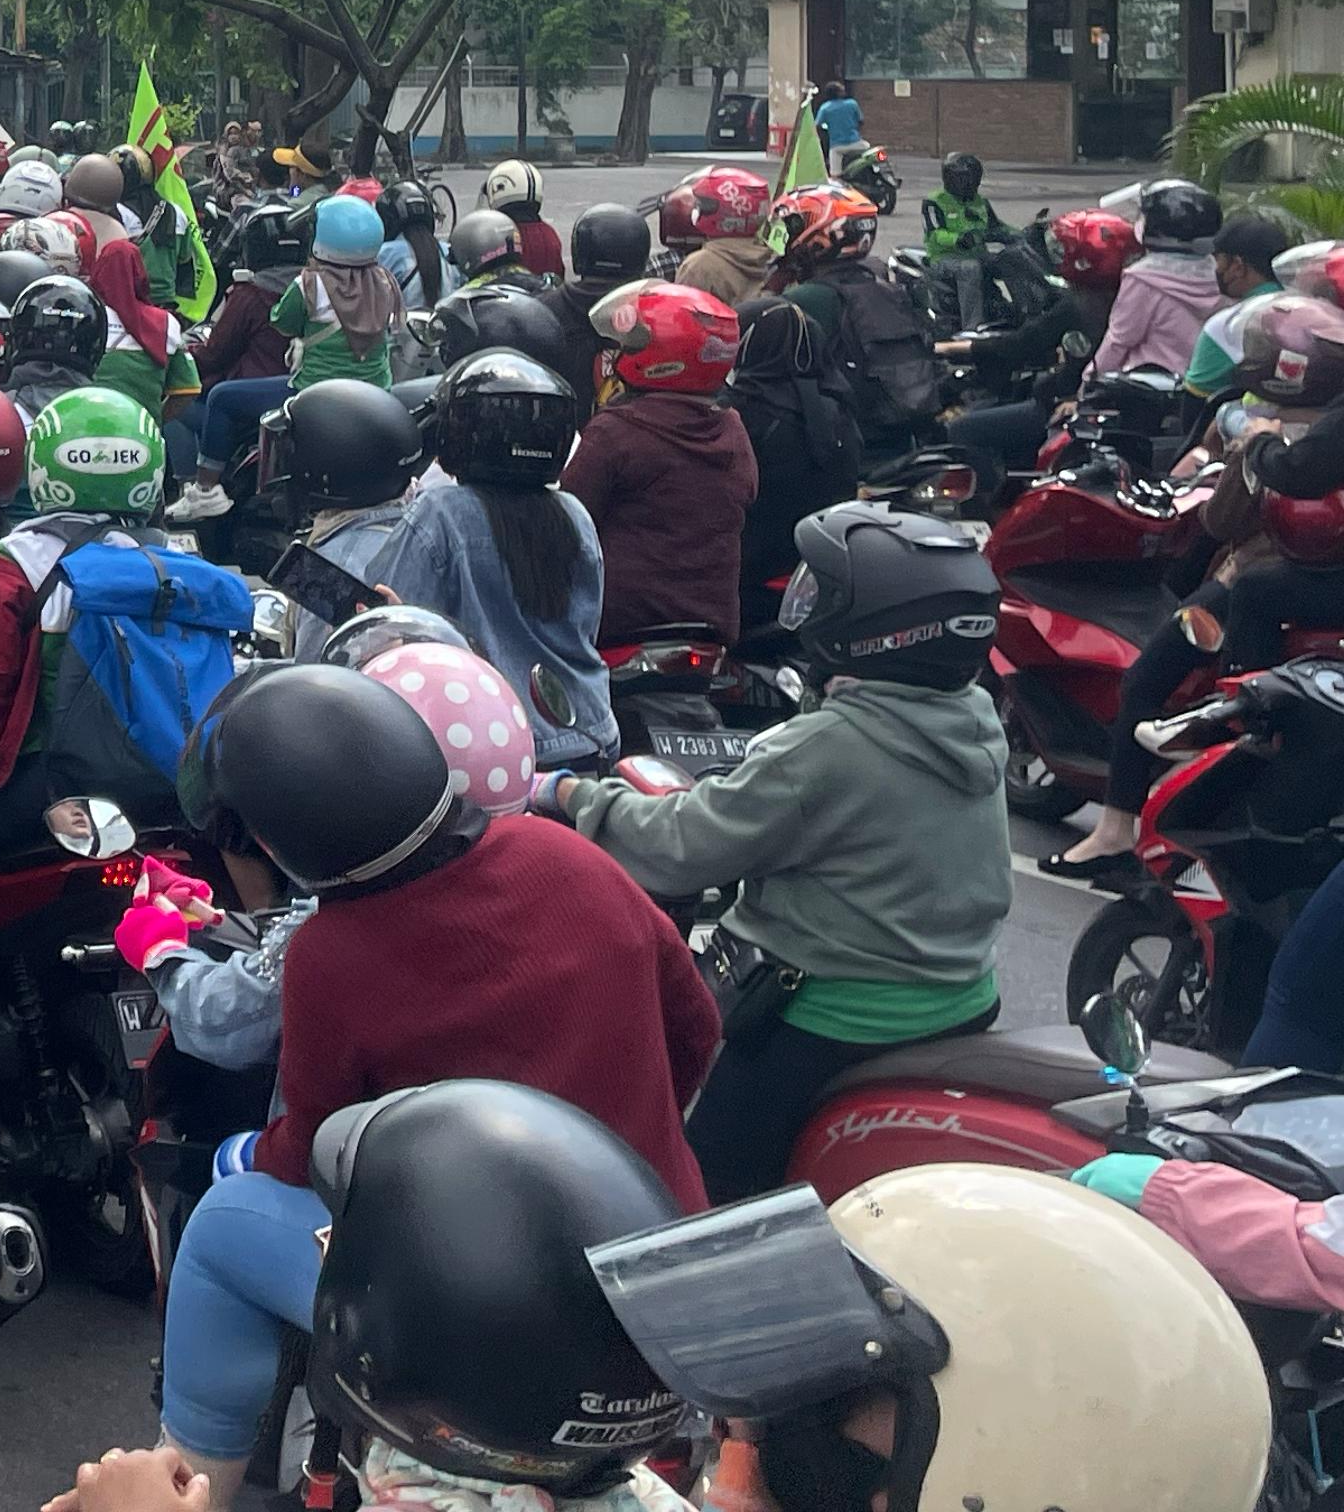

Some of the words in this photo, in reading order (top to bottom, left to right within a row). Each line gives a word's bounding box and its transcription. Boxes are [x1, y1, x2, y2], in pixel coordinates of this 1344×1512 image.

[67, 449, 91, 464] GO
[112, 449, 140, 464] JEK
[658, 735, 672, 755] W
[123, 1004, 141, 1031] W
